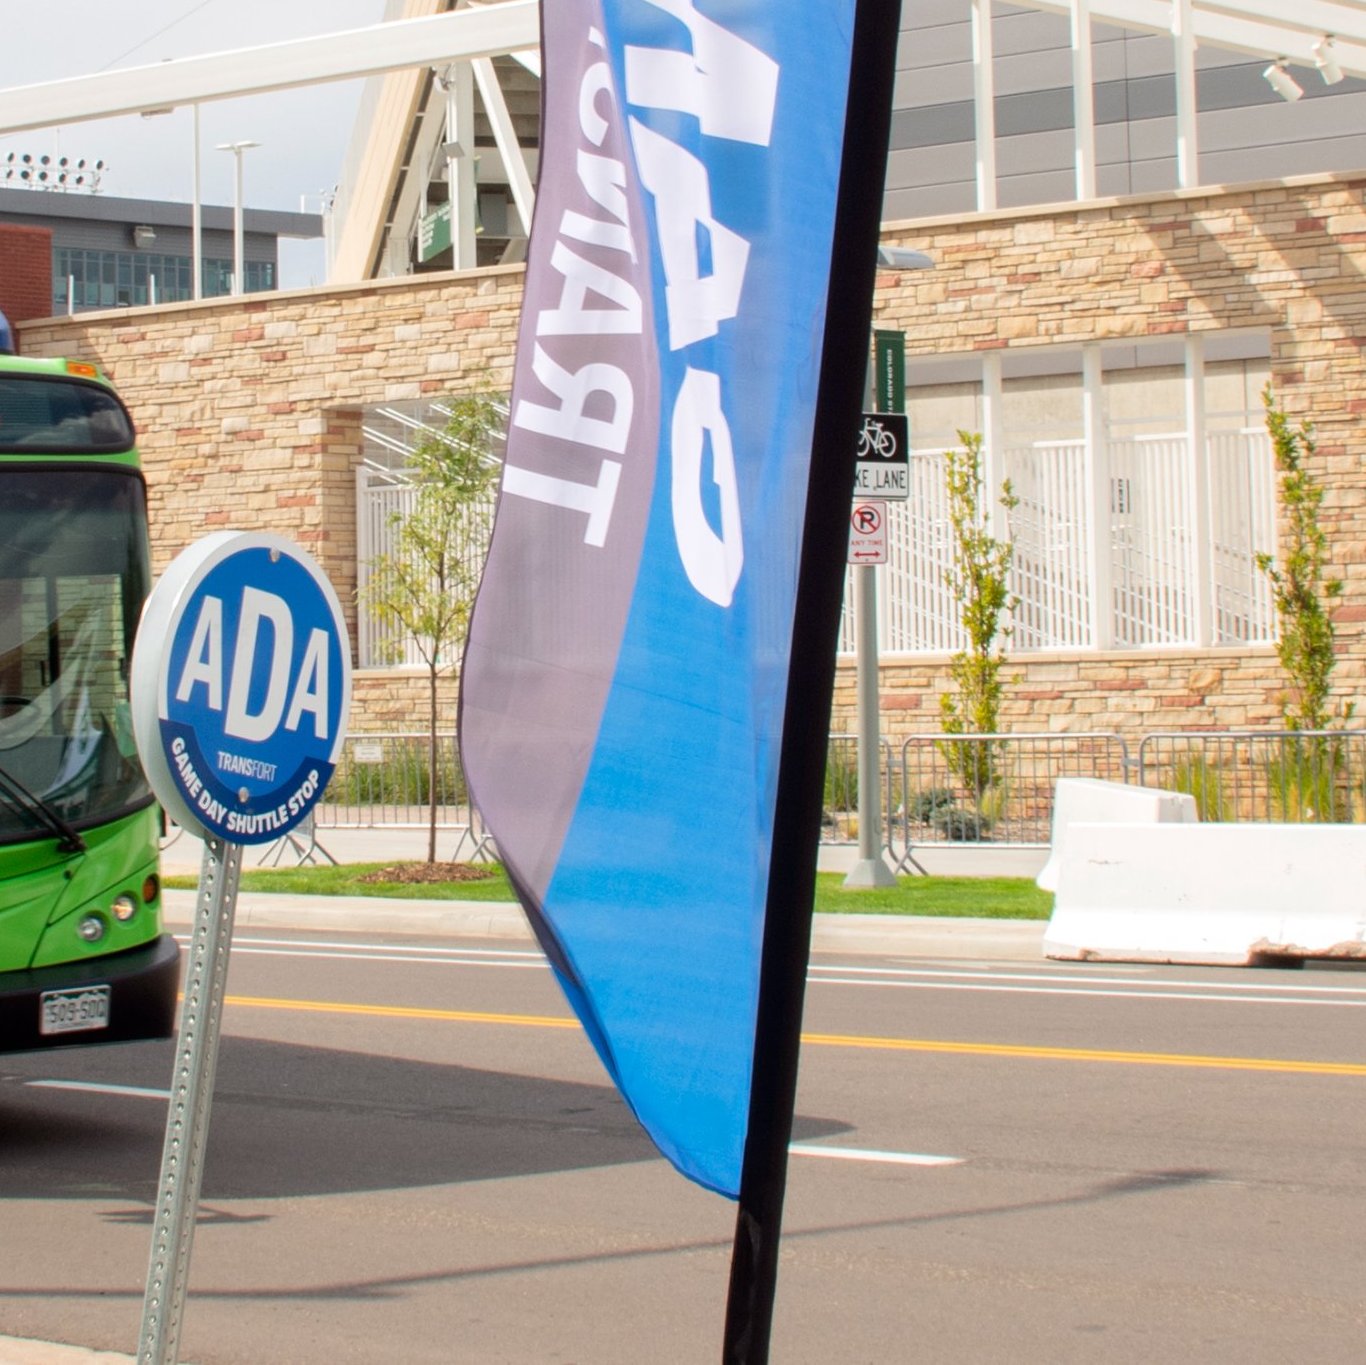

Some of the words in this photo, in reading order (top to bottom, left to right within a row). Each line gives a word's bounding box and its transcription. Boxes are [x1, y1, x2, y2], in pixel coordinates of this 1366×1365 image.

[876, 469, 907, 490] LANE
[176, 584, 330, 743] ADA
[170, 736, 202, 799] GAME
[198, 788, 228, 826] DAY
[227, 802, 290, 836] SHUTTLE
[287, 769, 321, 818] STOP
[217, 750, 278, 783] TRANSFORT
